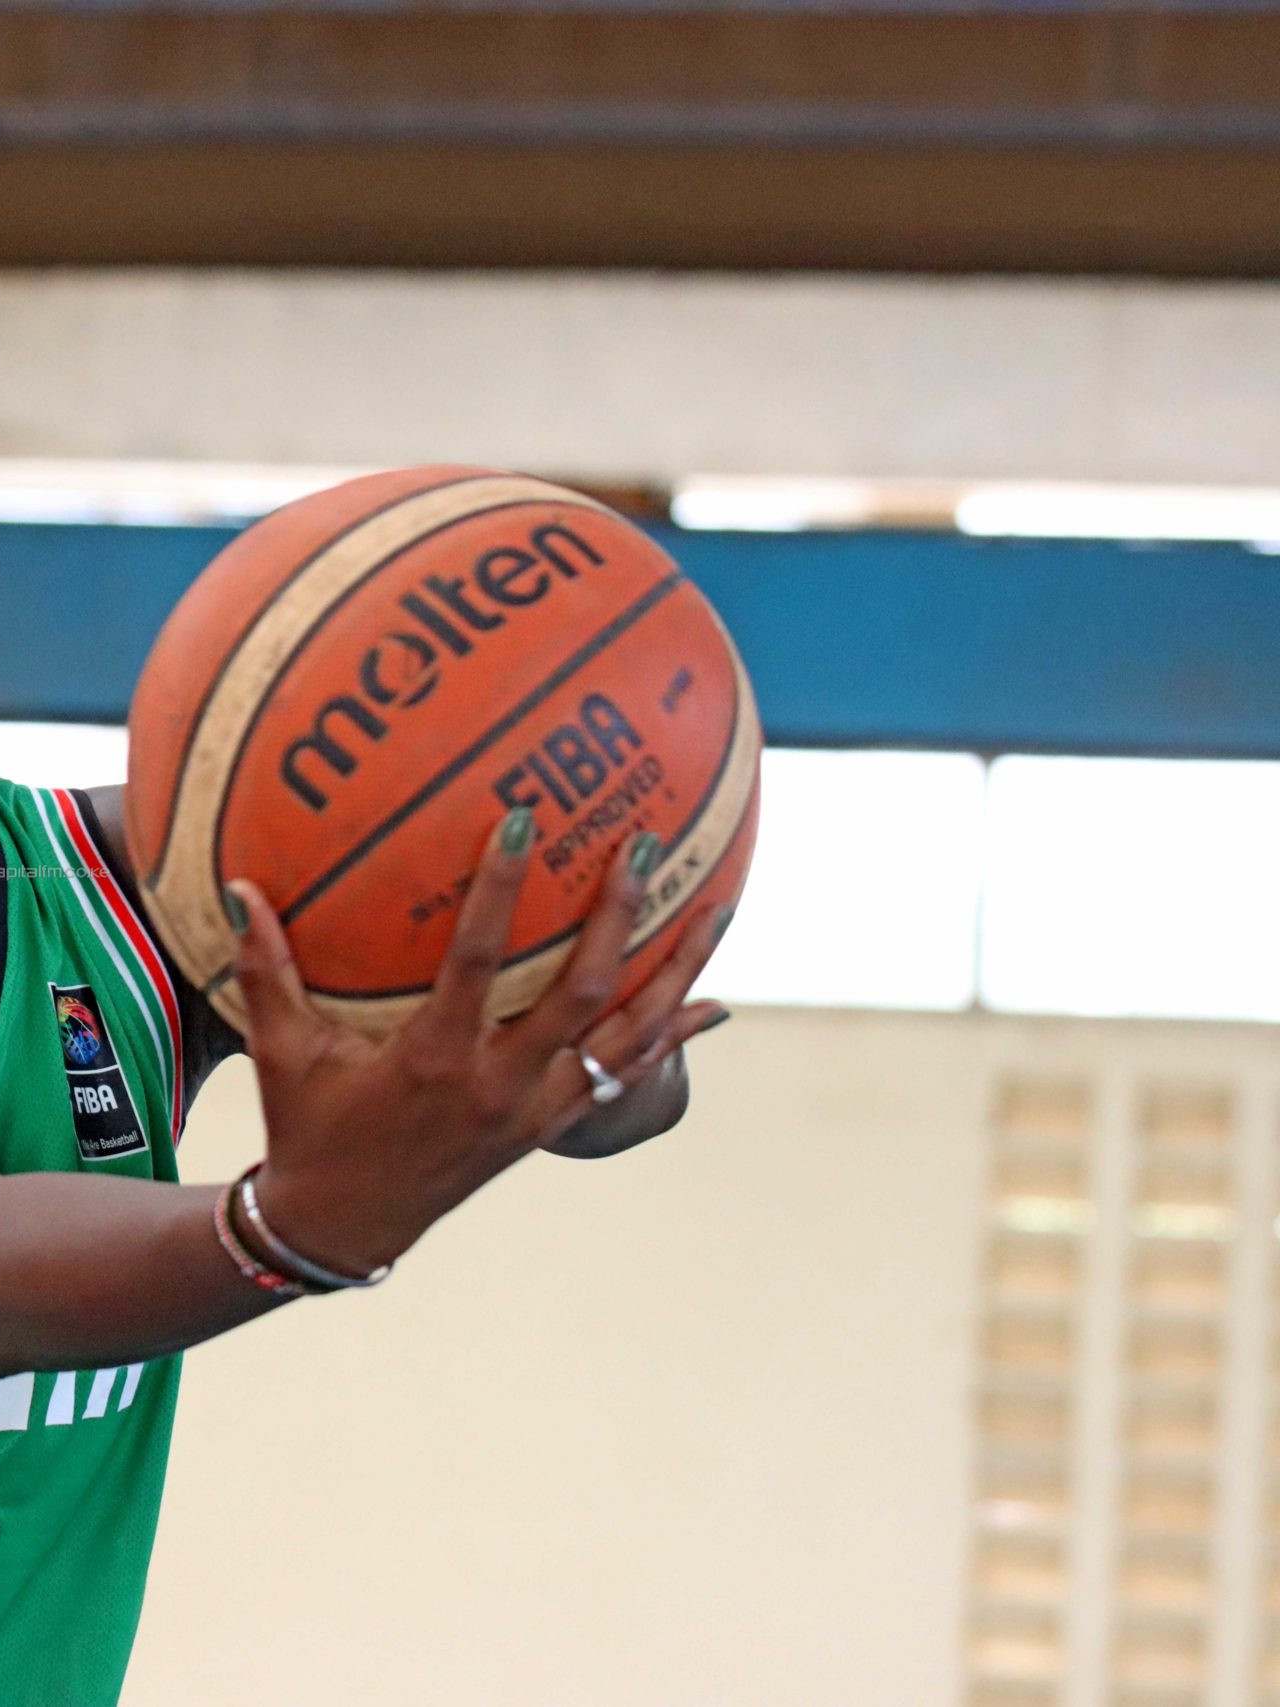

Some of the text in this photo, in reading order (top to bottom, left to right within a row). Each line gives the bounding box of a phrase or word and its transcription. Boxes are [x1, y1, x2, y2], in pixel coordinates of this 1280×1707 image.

[278, 521, 607, 814] molten
[491, 692, 643, 838] FIBA
[543, 754, 664, 875] APPROVED
[73, 1084, 119, 1114] FIBA
[99, 1129, 139, 1150] Basketball
